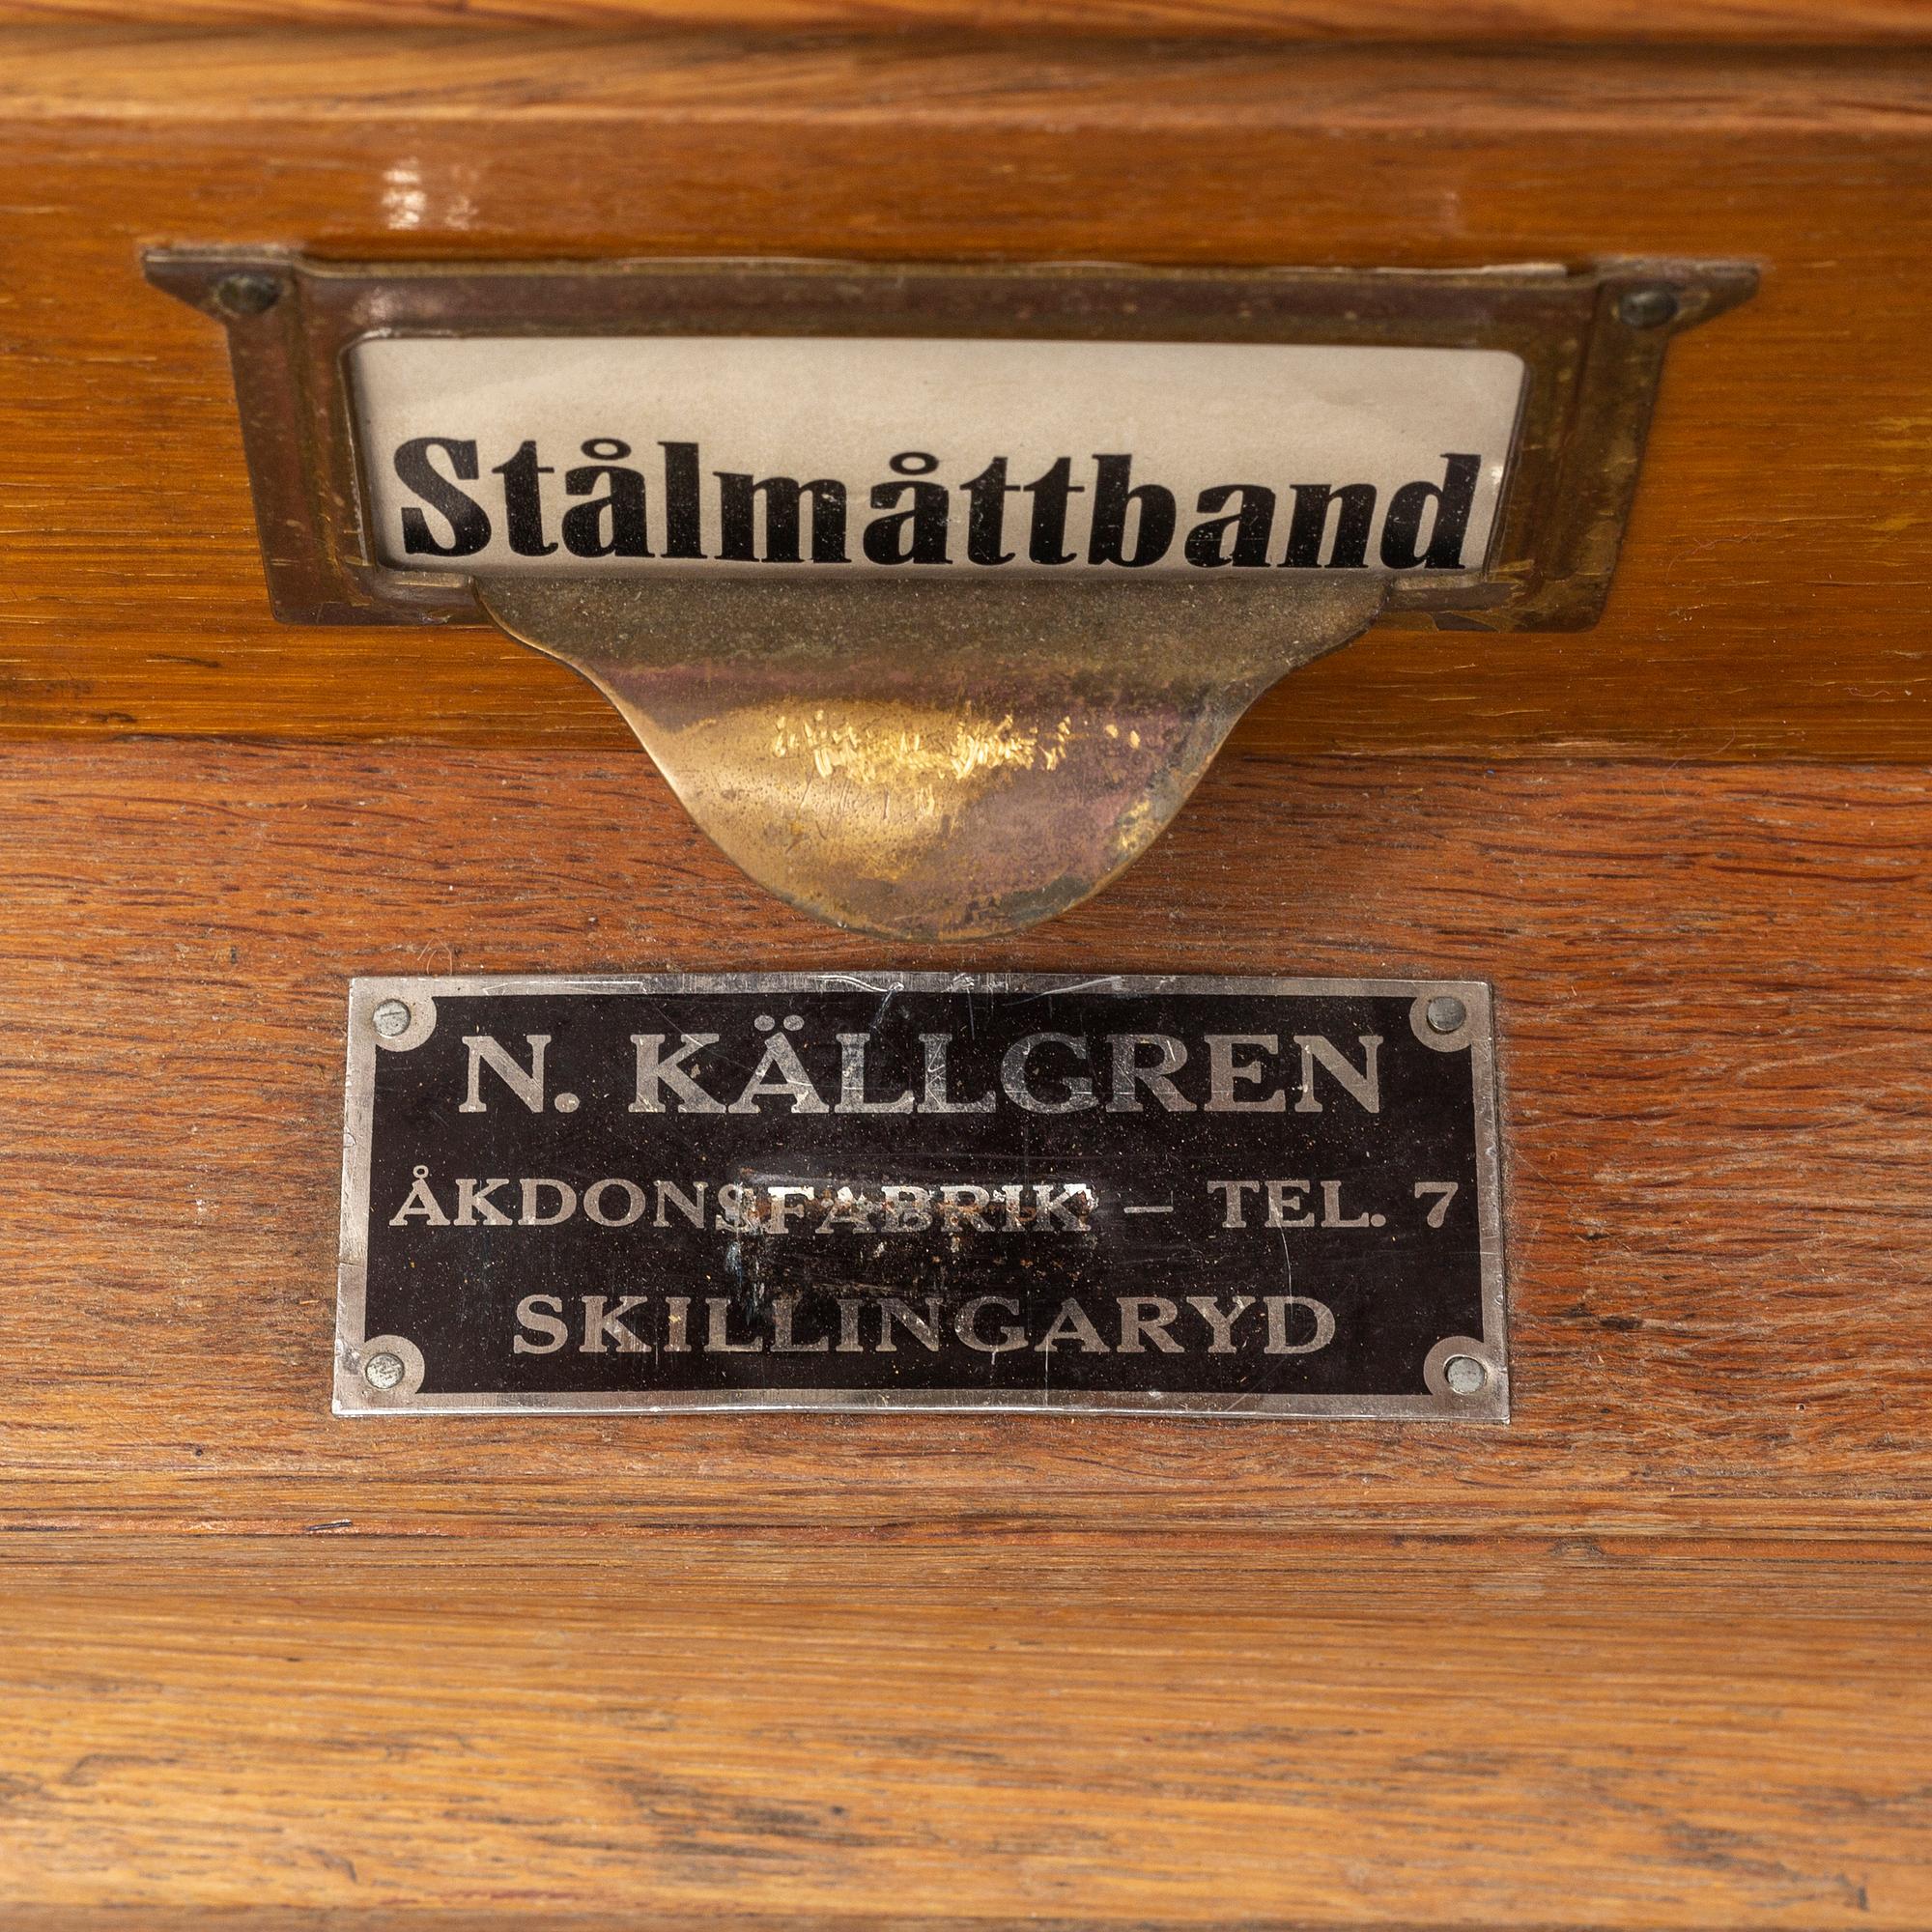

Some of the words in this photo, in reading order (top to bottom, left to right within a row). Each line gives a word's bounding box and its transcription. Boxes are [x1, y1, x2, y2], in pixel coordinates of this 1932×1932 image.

[393, 437, 1480, 570] Stålmåttband
[458, 1034, 581, 1114] N.
[628, 1014, 1384, 1114] KÄLLGREN
[388, 1165, 1098, 1235] ÅKDONSFABRIK
[1207, 1179, 1387, 1229] TEL.
[1413, 1181, 1459, 1229] 7
[513, 1293, 1337, 1354] SKILLINGARYD
